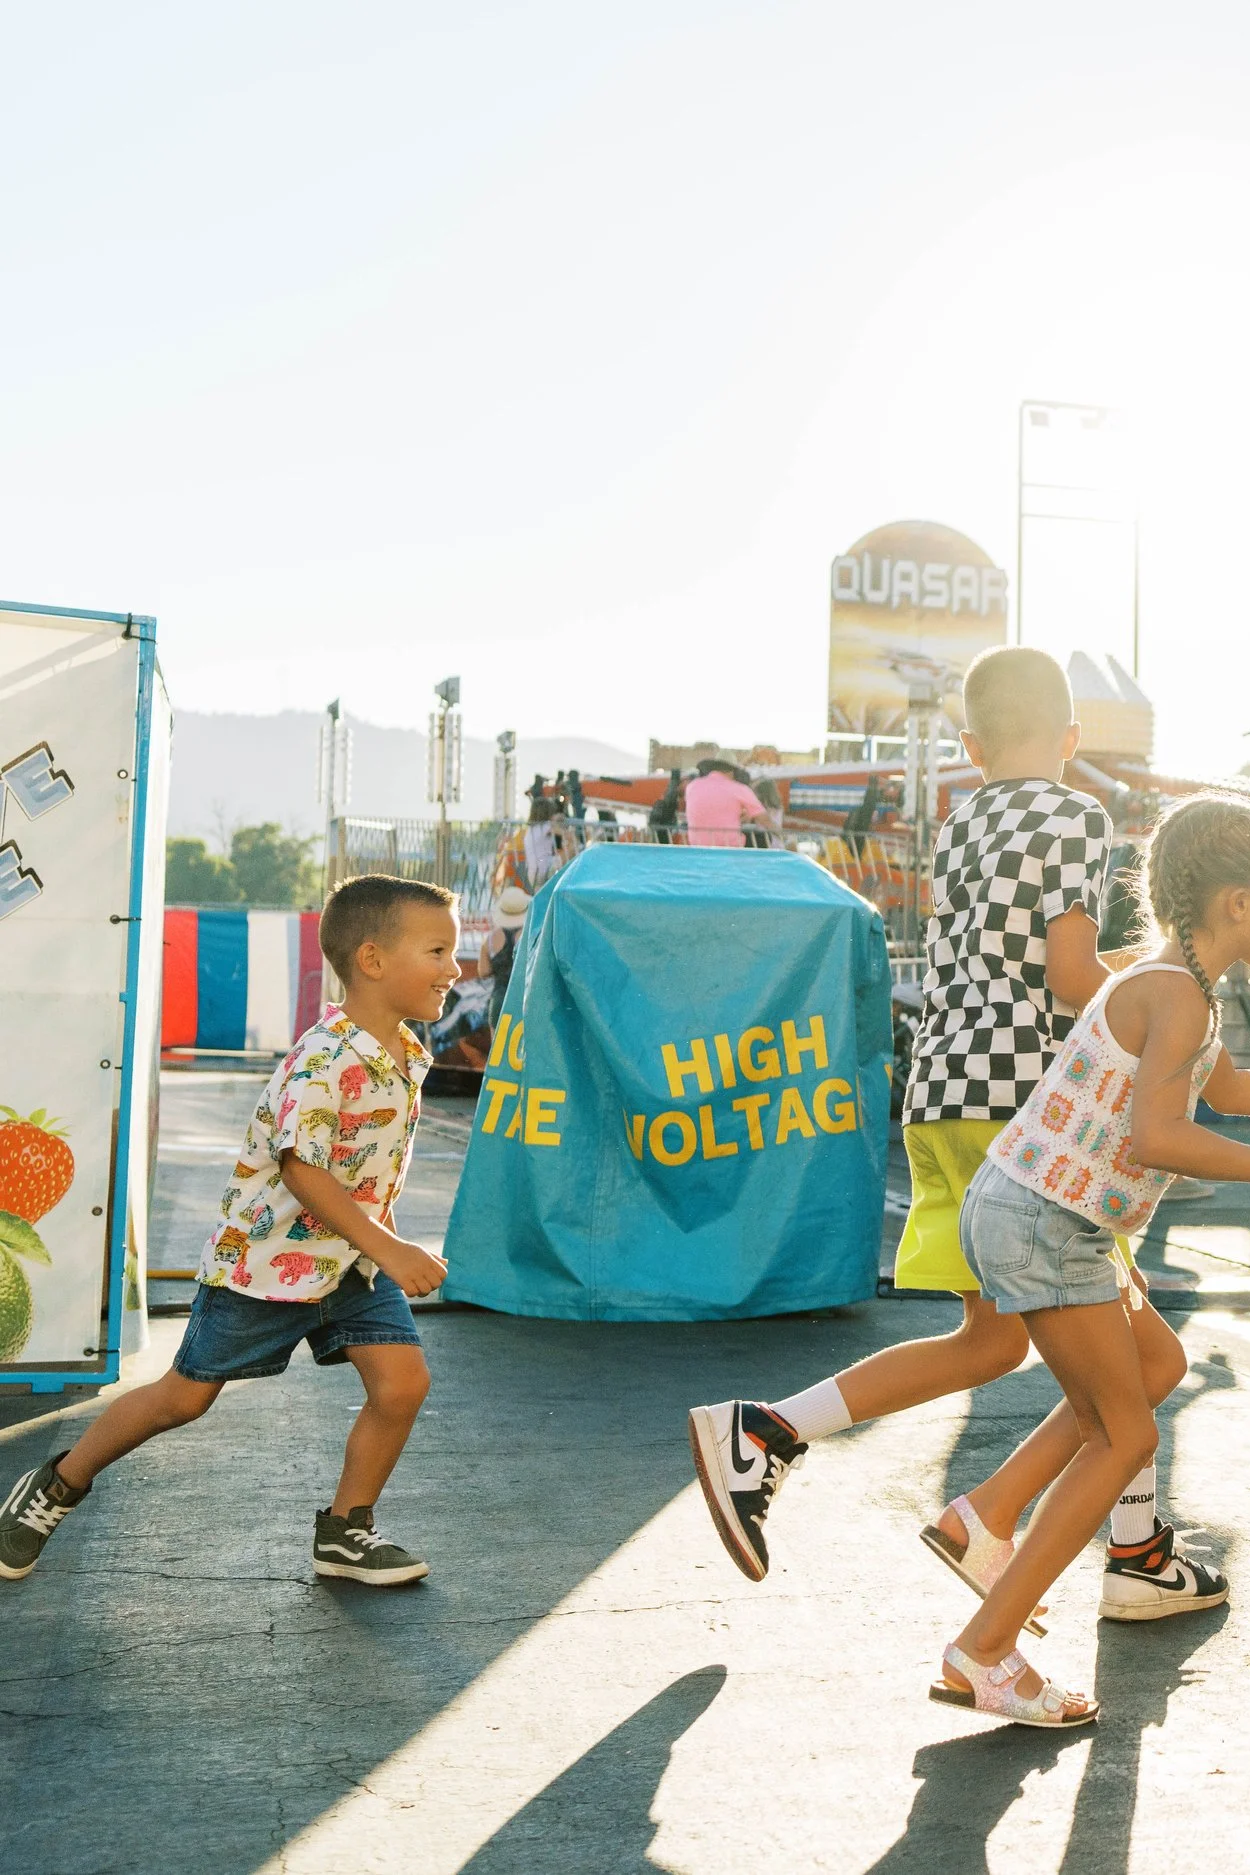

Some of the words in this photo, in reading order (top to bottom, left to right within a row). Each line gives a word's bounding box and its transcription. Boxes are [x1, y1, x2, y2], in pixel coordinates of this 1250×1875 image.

[832, 552, 1007, 618] QUASAR
[661, 1015, 828, 1098] HIGH
[622, 1078, 863, 1166] VOLTAG
